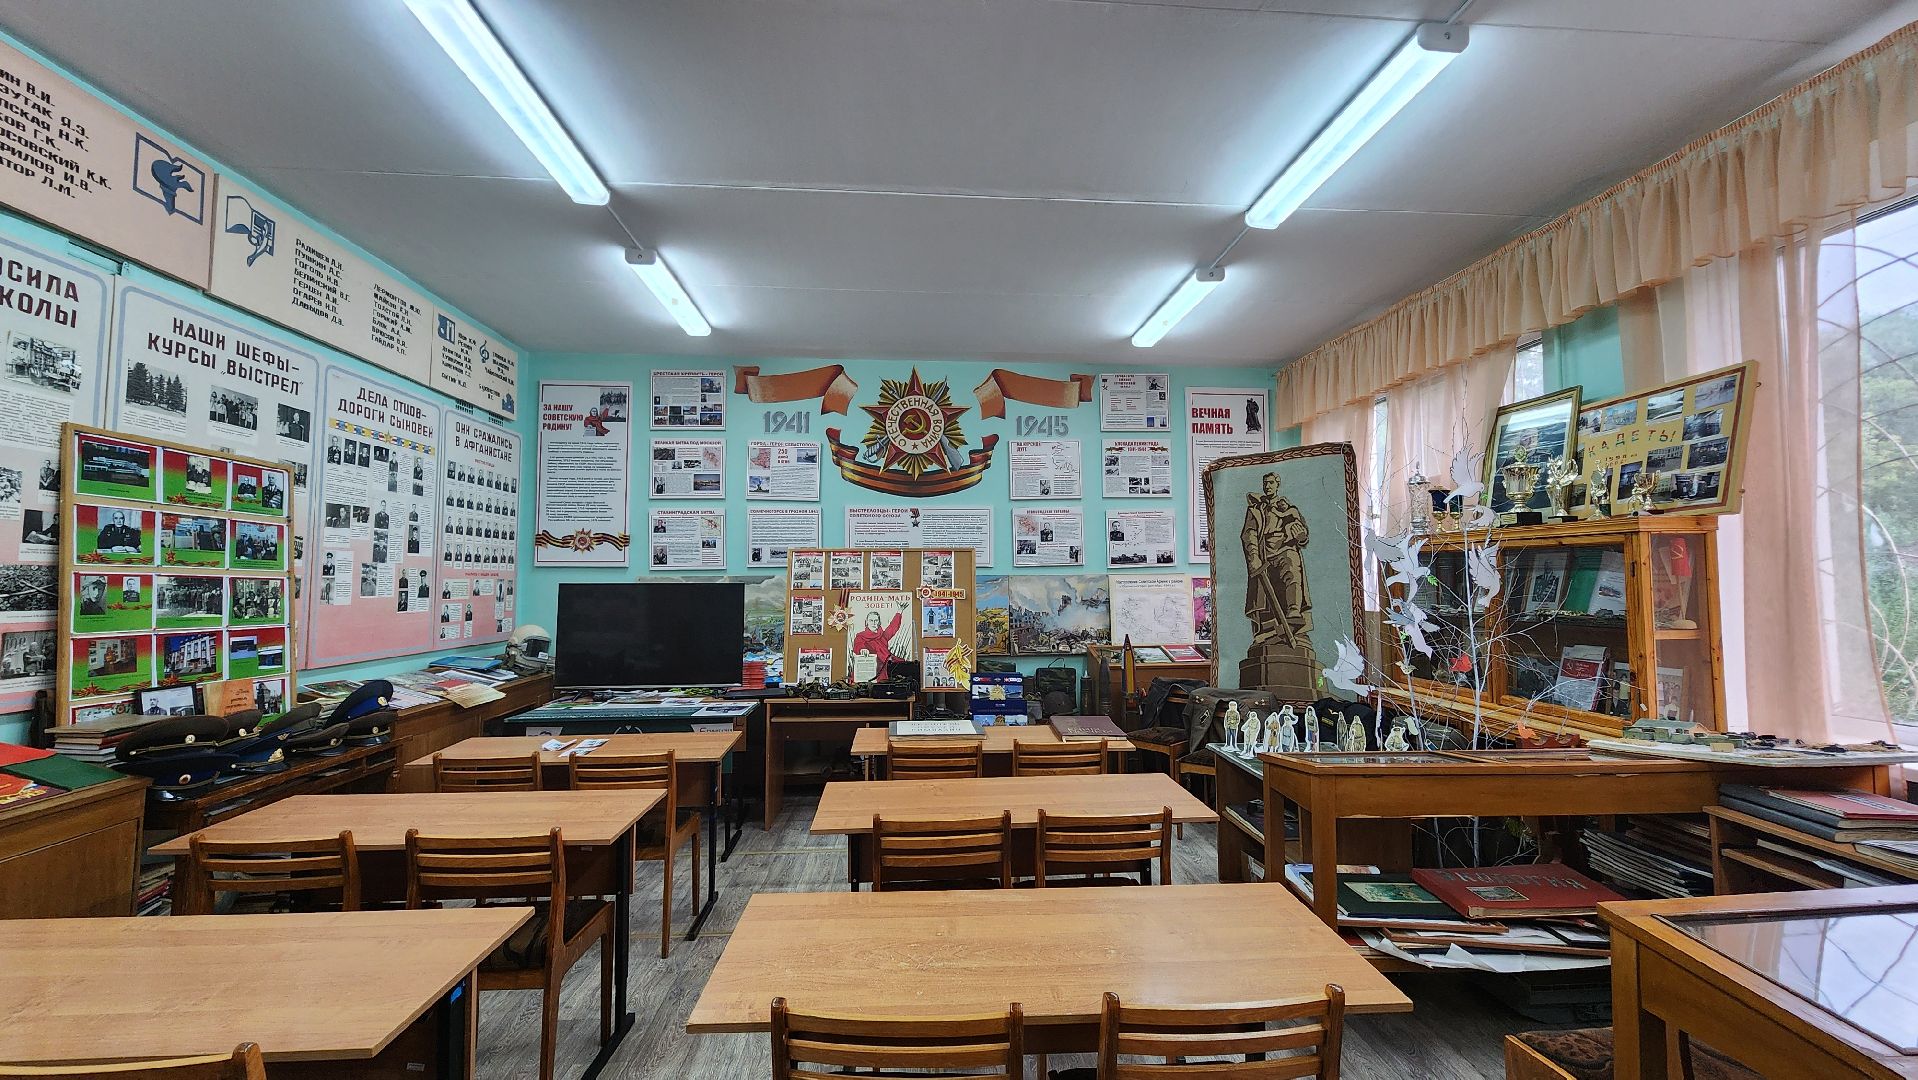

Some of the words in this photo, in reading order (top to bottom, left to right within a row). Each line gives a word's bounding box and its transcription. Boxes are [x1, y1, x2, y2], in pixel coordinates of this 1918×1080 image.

[27, 82, 55, 107] В.И.
[61, 116, 90, 139] Я.Э.
[33, 129, 61, 151] Г.К.
[59, 129, 89, 153] Н.К.
[41, 176, 76, 199] Л.М.
[64, 172, 93, 194] И.В.
[87, 169, 112, 190] К.К.
[295, 248, 326, 271] ПУШКИН
[295, 258, 324, 279] ГОГОЛЬ
[0, 256, 79, 303] СИЛА
[293, 277, 322, 297] ГЕРЦЕН
[294, 268, 337, 294] БЕЛИНСКИЙ
[292, 297, 329, 319] ДАВЫДОВ
[293, 287, 323, 307] ОГАРЕВ
[374, 300, 400, 319] ТОЛСТОЙ
[173, 317, 226, 351] НАШИ
[371, 334, 395, 350] ГАЙДАР
[148, 332, 216, 370] КУРСЫ
[356, 387, 388, 408] ДЕЛА
[553, 404, 574, 412] НАШУ
[338, 398, 385, 424] ДОРОГИ
[389, 415, 434, 439] СЫНОВЕЙ
[543, 413, 584, 422] СОВЕТСКУЮ
[763, 411, 811, 435] 1941
[888, 397, 940, 447] ОТЕЧЕСТВЕННАЯ
[921, 419, 944, 449] ВОЙНА
[1192, 407, 1231, 419] ВЕЧНАЯ
[455, 421, 470, 436] ОНИ
[473, 428, 513, 450] СРАЖАЛИСЬ
[542, 423, 572, 431] РОДИНУ!
[1016, 415, 1069, 438] 1945
[1192, 422, 1233, 435] ПАМЯТЬ
[455, 436, 460, 447] В
[464, 438, 512, 463] АФГАНИСТАНЕ
